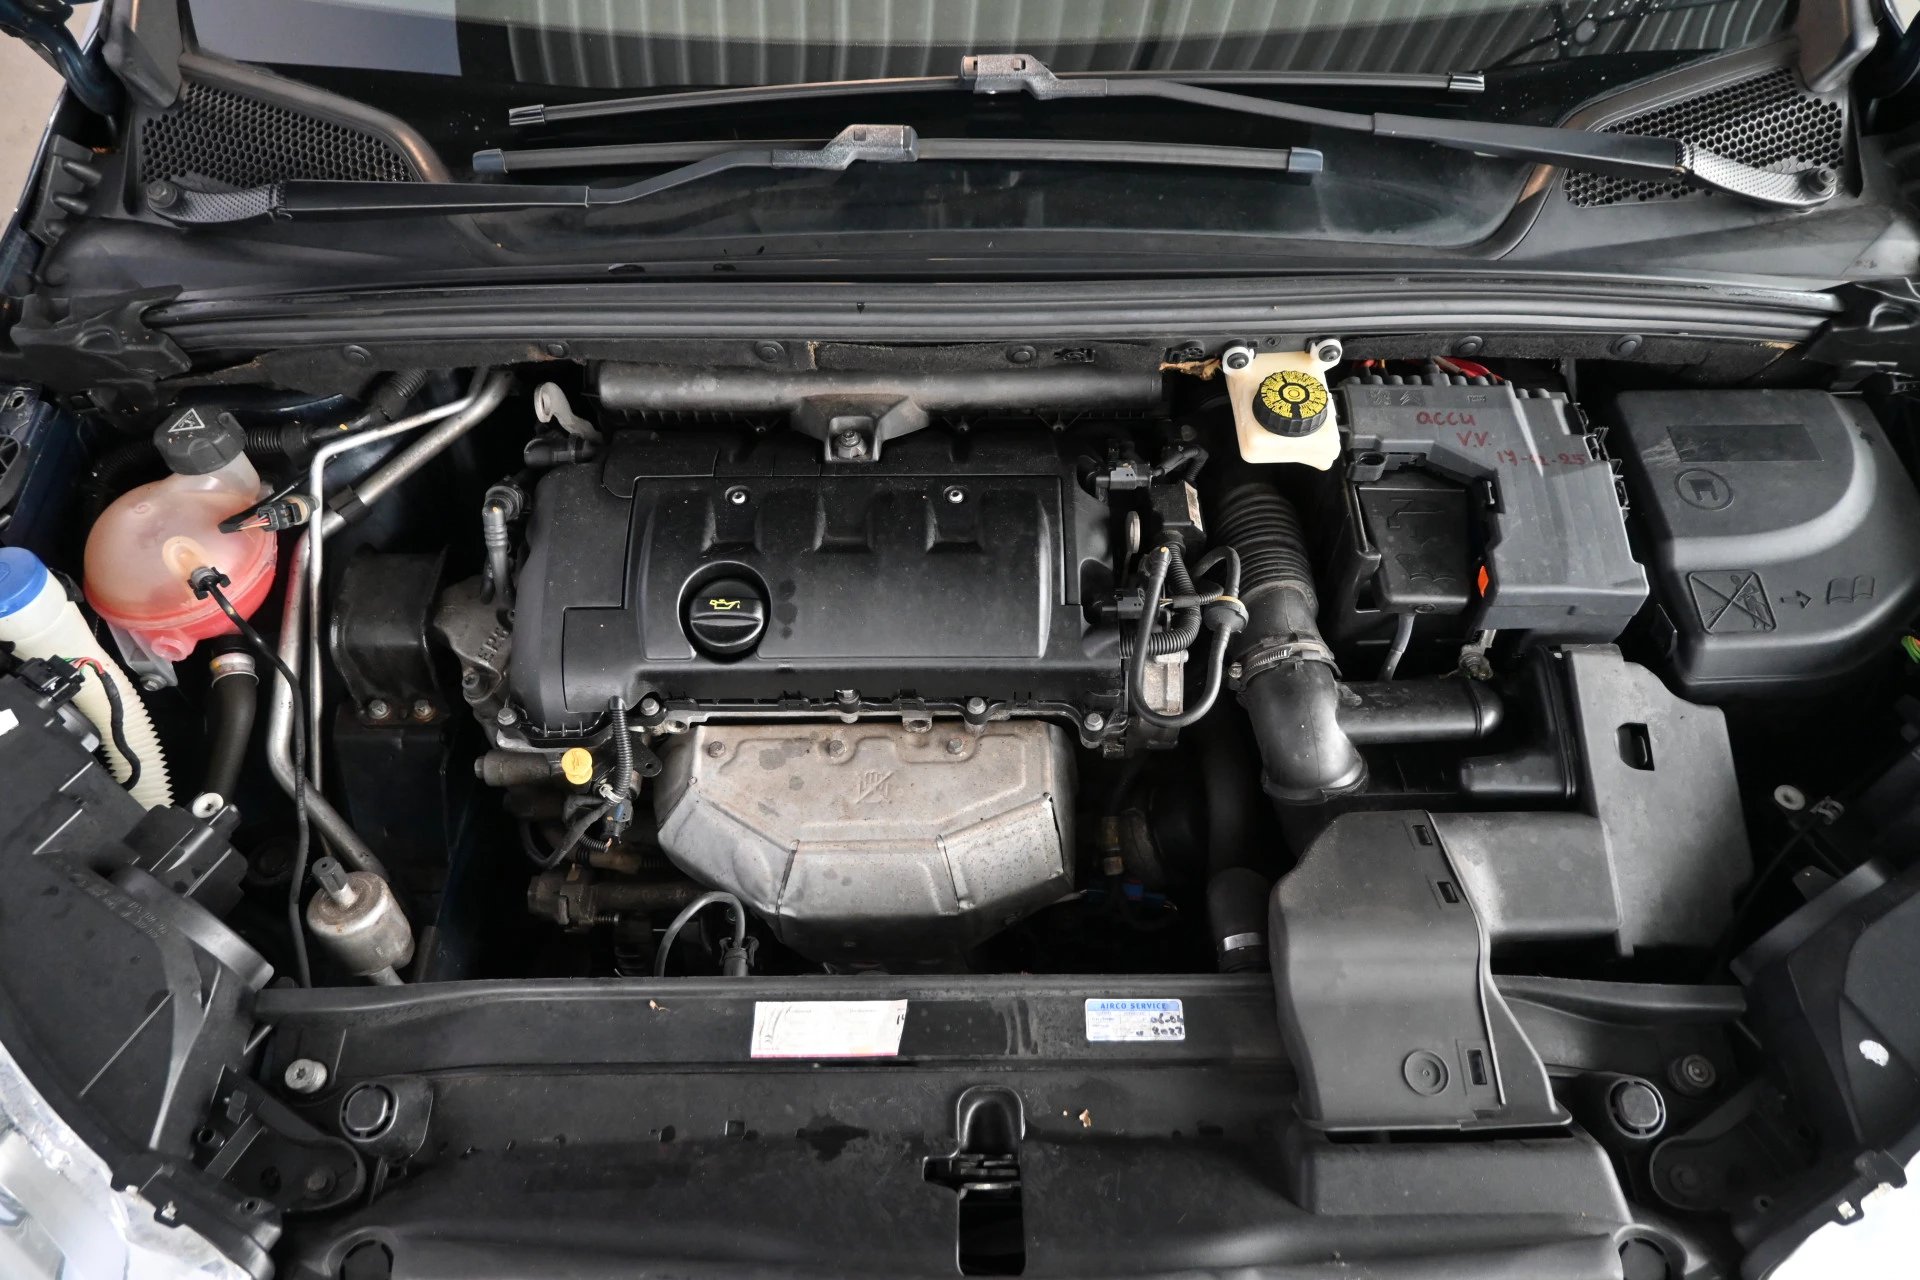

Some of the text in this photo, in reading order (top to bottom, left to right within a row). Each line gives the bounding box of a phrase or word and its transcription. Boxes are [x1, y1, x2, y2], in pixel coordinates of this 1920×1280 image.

[1416, 411, 1476, 426] accu
[1100, 1002, 1167, 1010] AIRCO SERVICE
